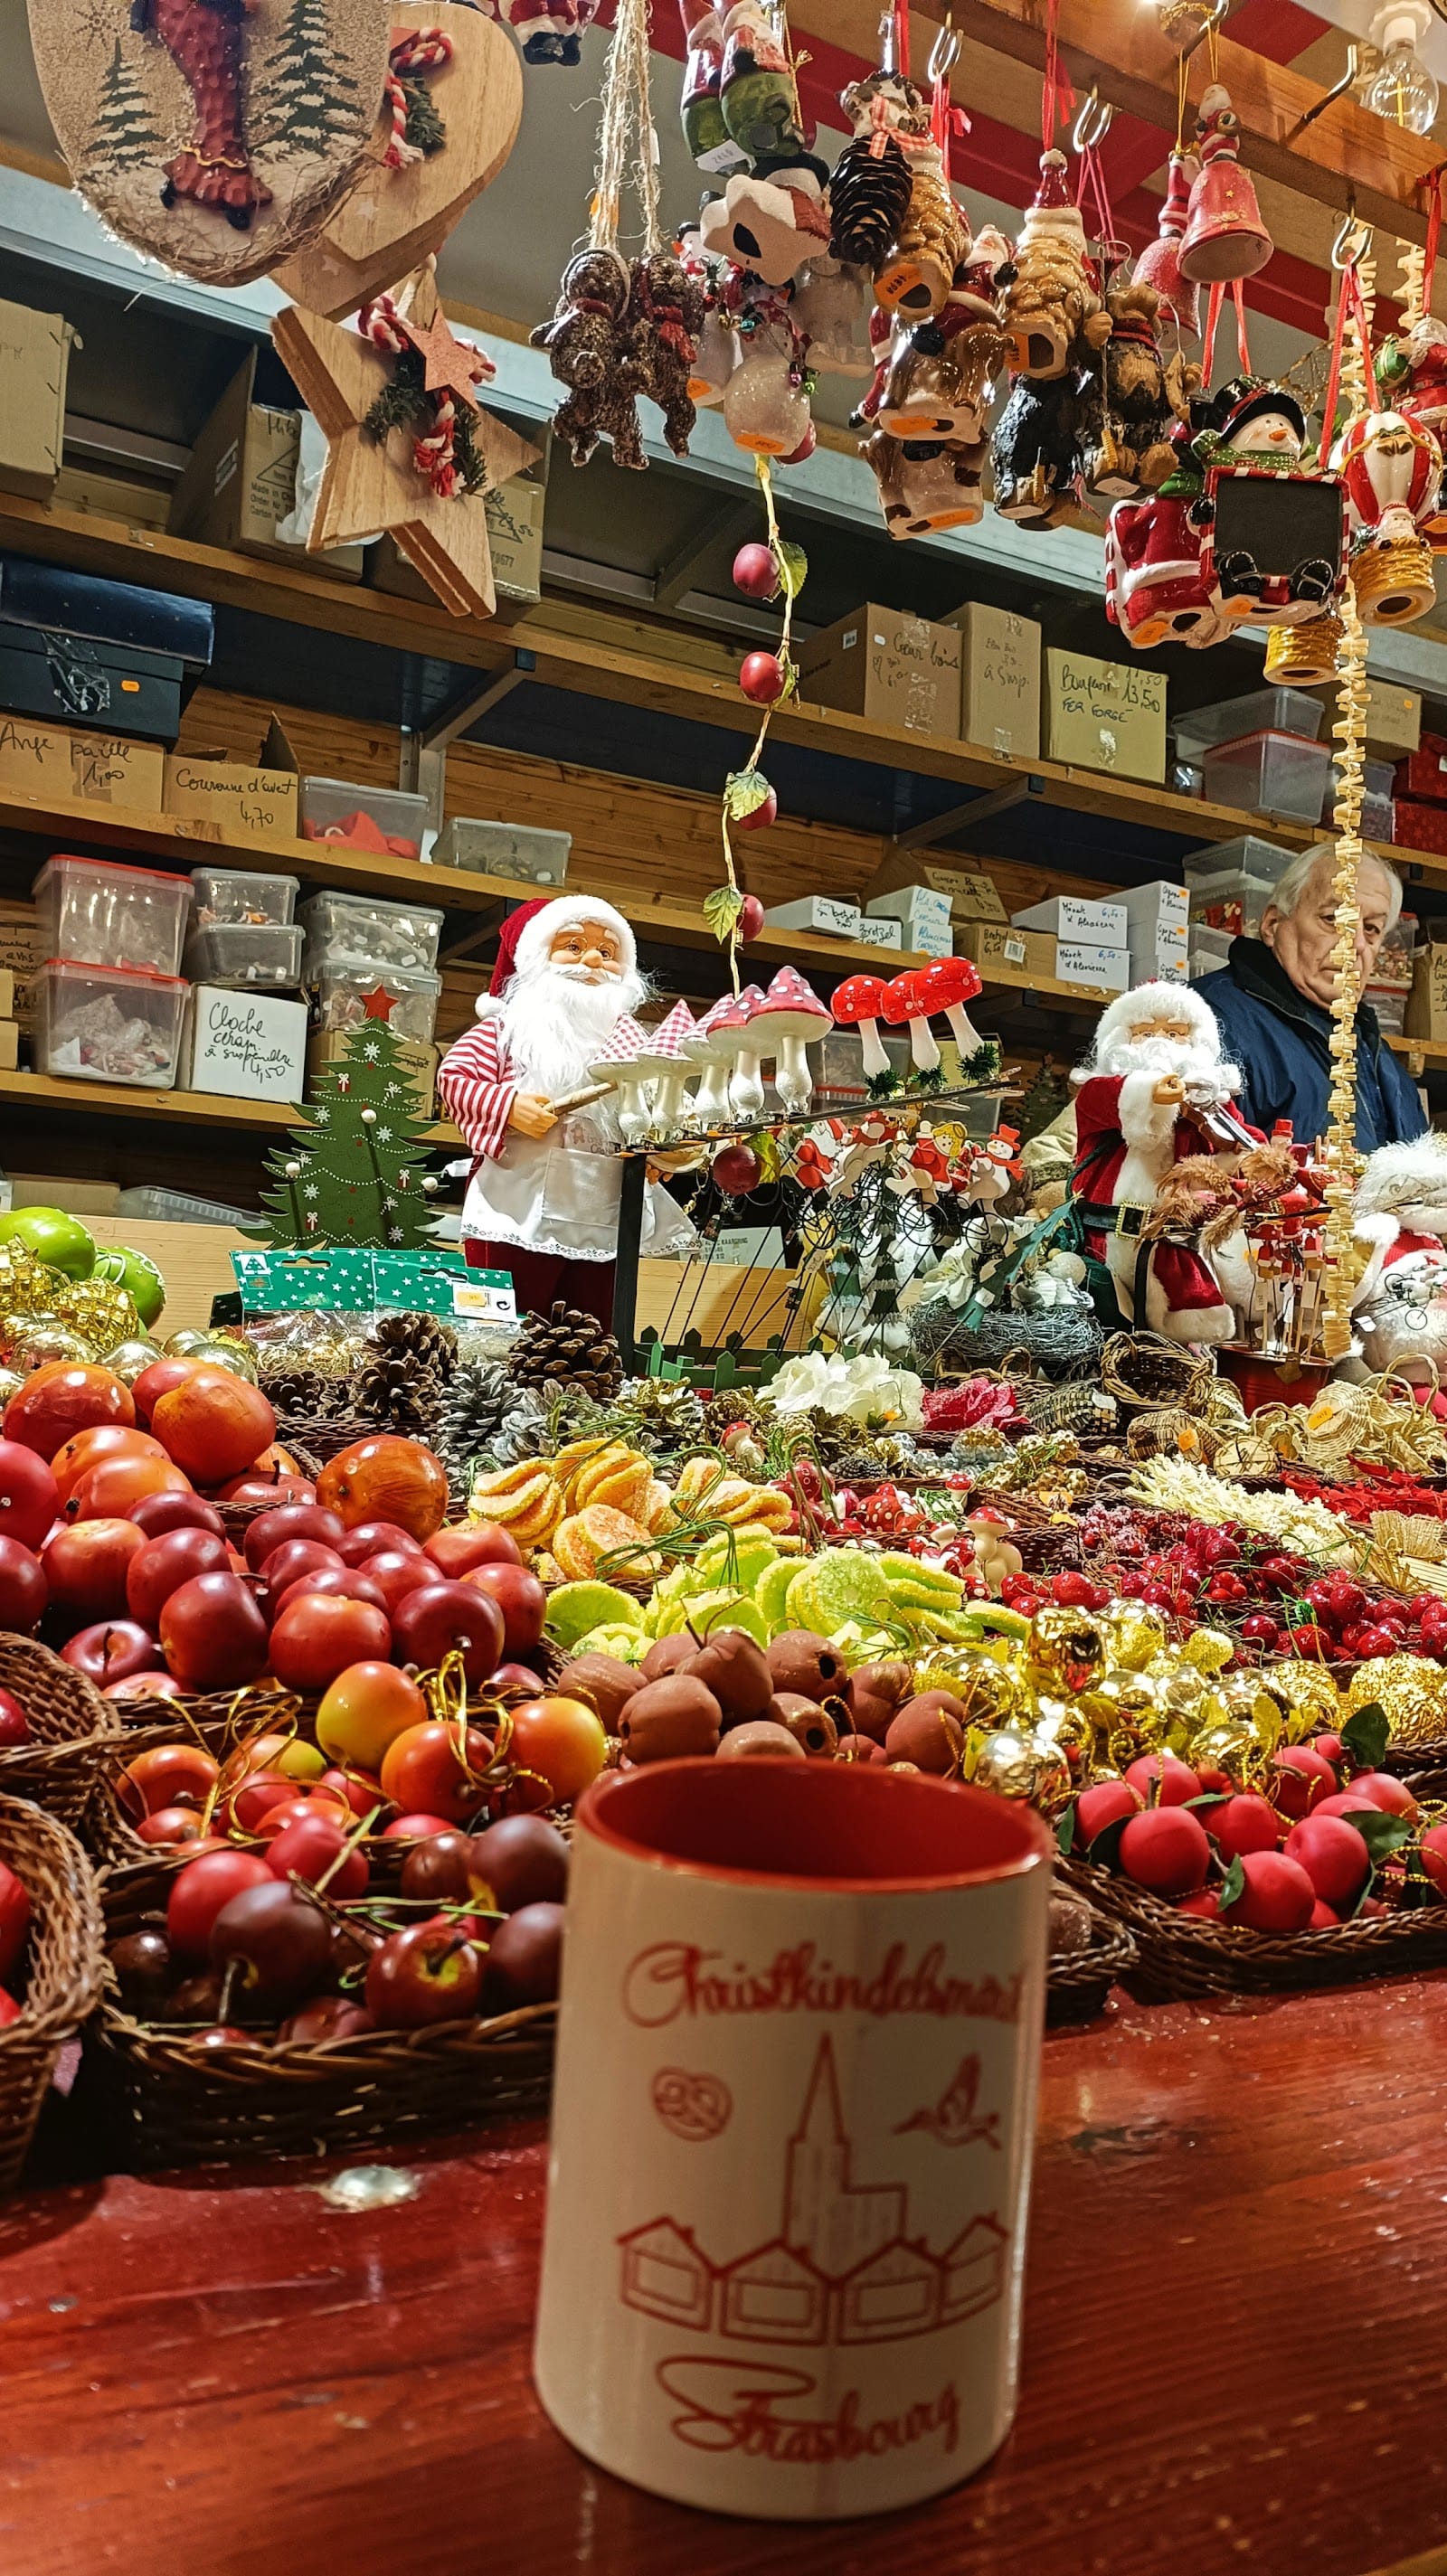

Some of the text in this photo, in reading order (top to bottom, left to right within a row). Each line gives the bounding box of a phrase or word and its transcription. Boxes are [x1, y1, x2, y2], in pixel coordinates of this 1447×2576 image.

[241, 800, 274, 829] 4,70
[209, 1002, 266, 1038] Cloche
[250, 1058, 286, 1084] 4,50
[655, 2354, 960, 2465] Strasbourg
